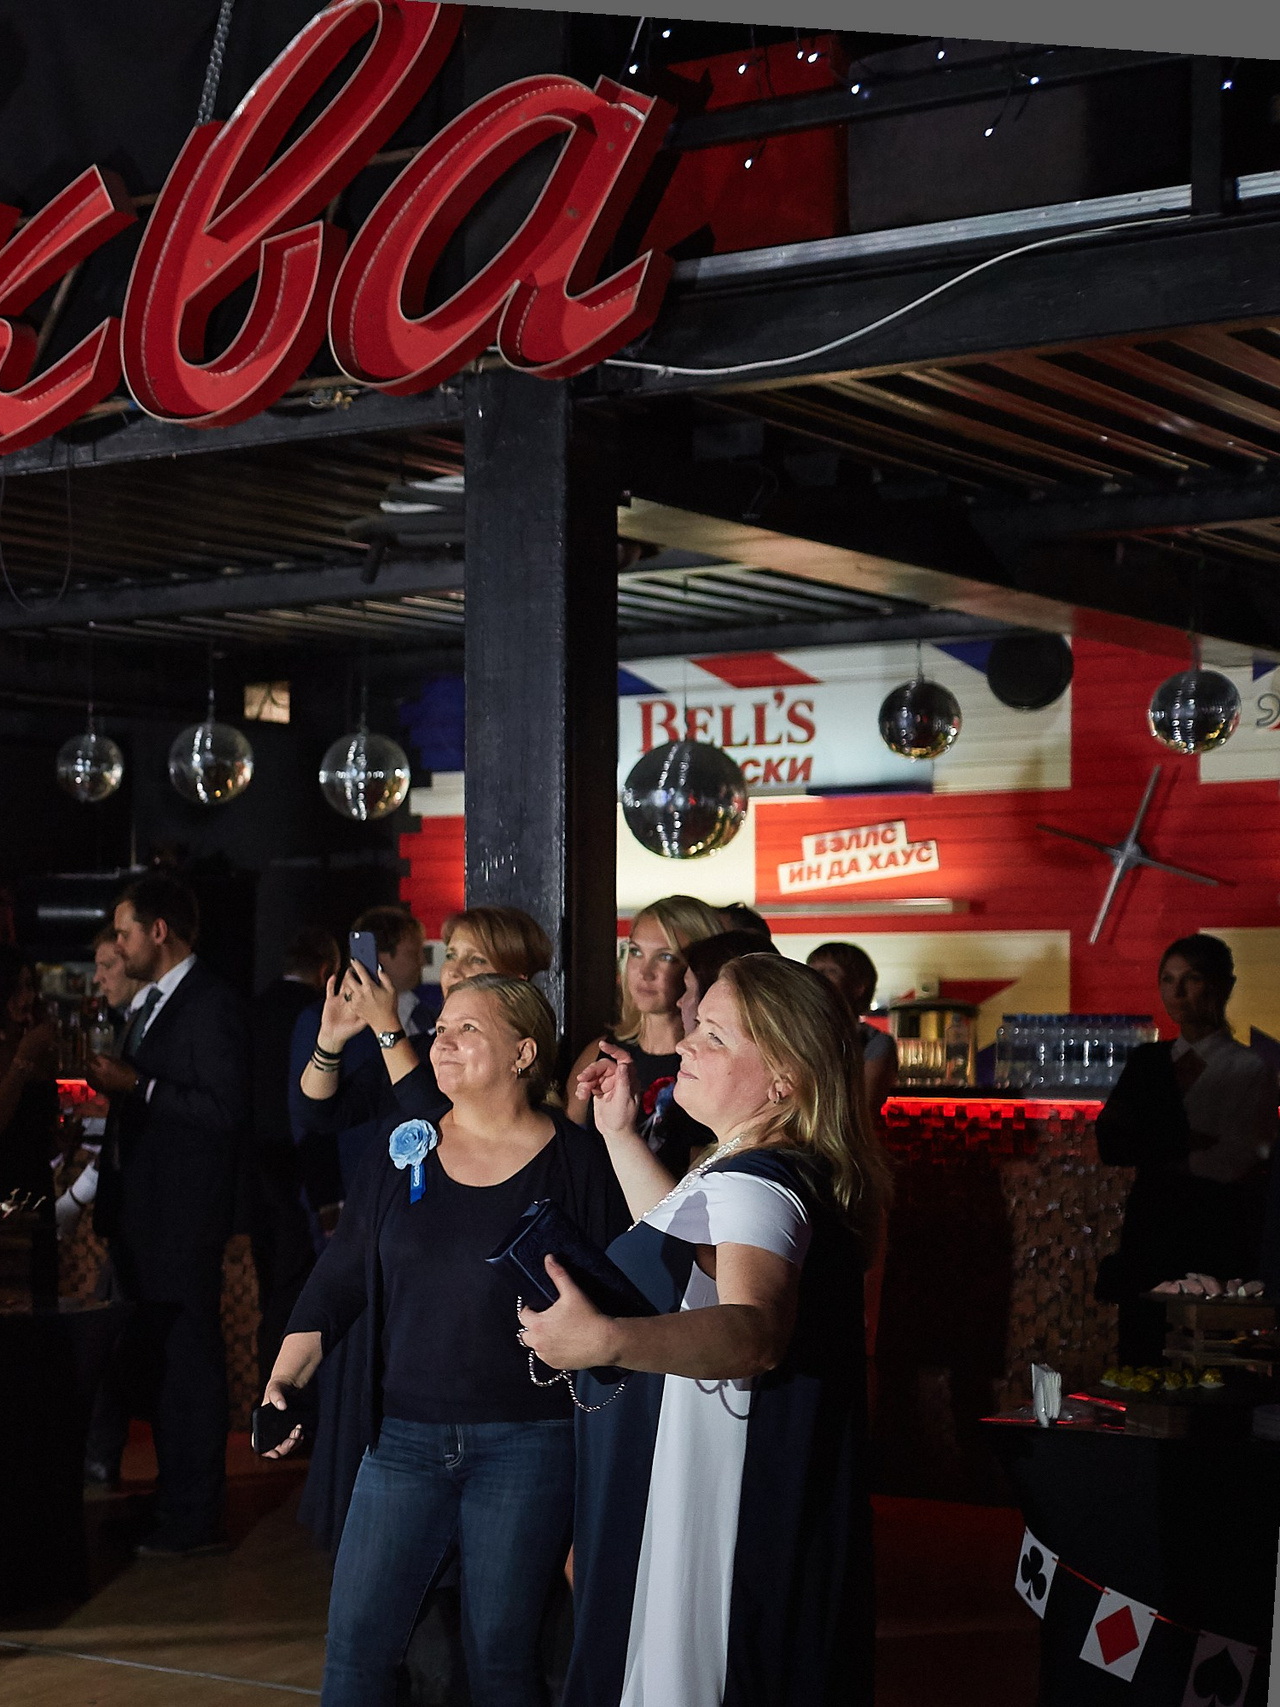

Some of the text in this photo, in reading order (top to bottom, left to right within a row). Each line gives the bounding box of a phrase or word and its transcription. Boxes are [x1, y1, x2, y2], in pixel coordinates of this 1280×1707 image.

[638, 688, 816, 753] BELL'S
[739, 757, 813, 784] СКИ
[827, 858, 861, 880] ДА
[868, 846, 932, 871] ХАУС
